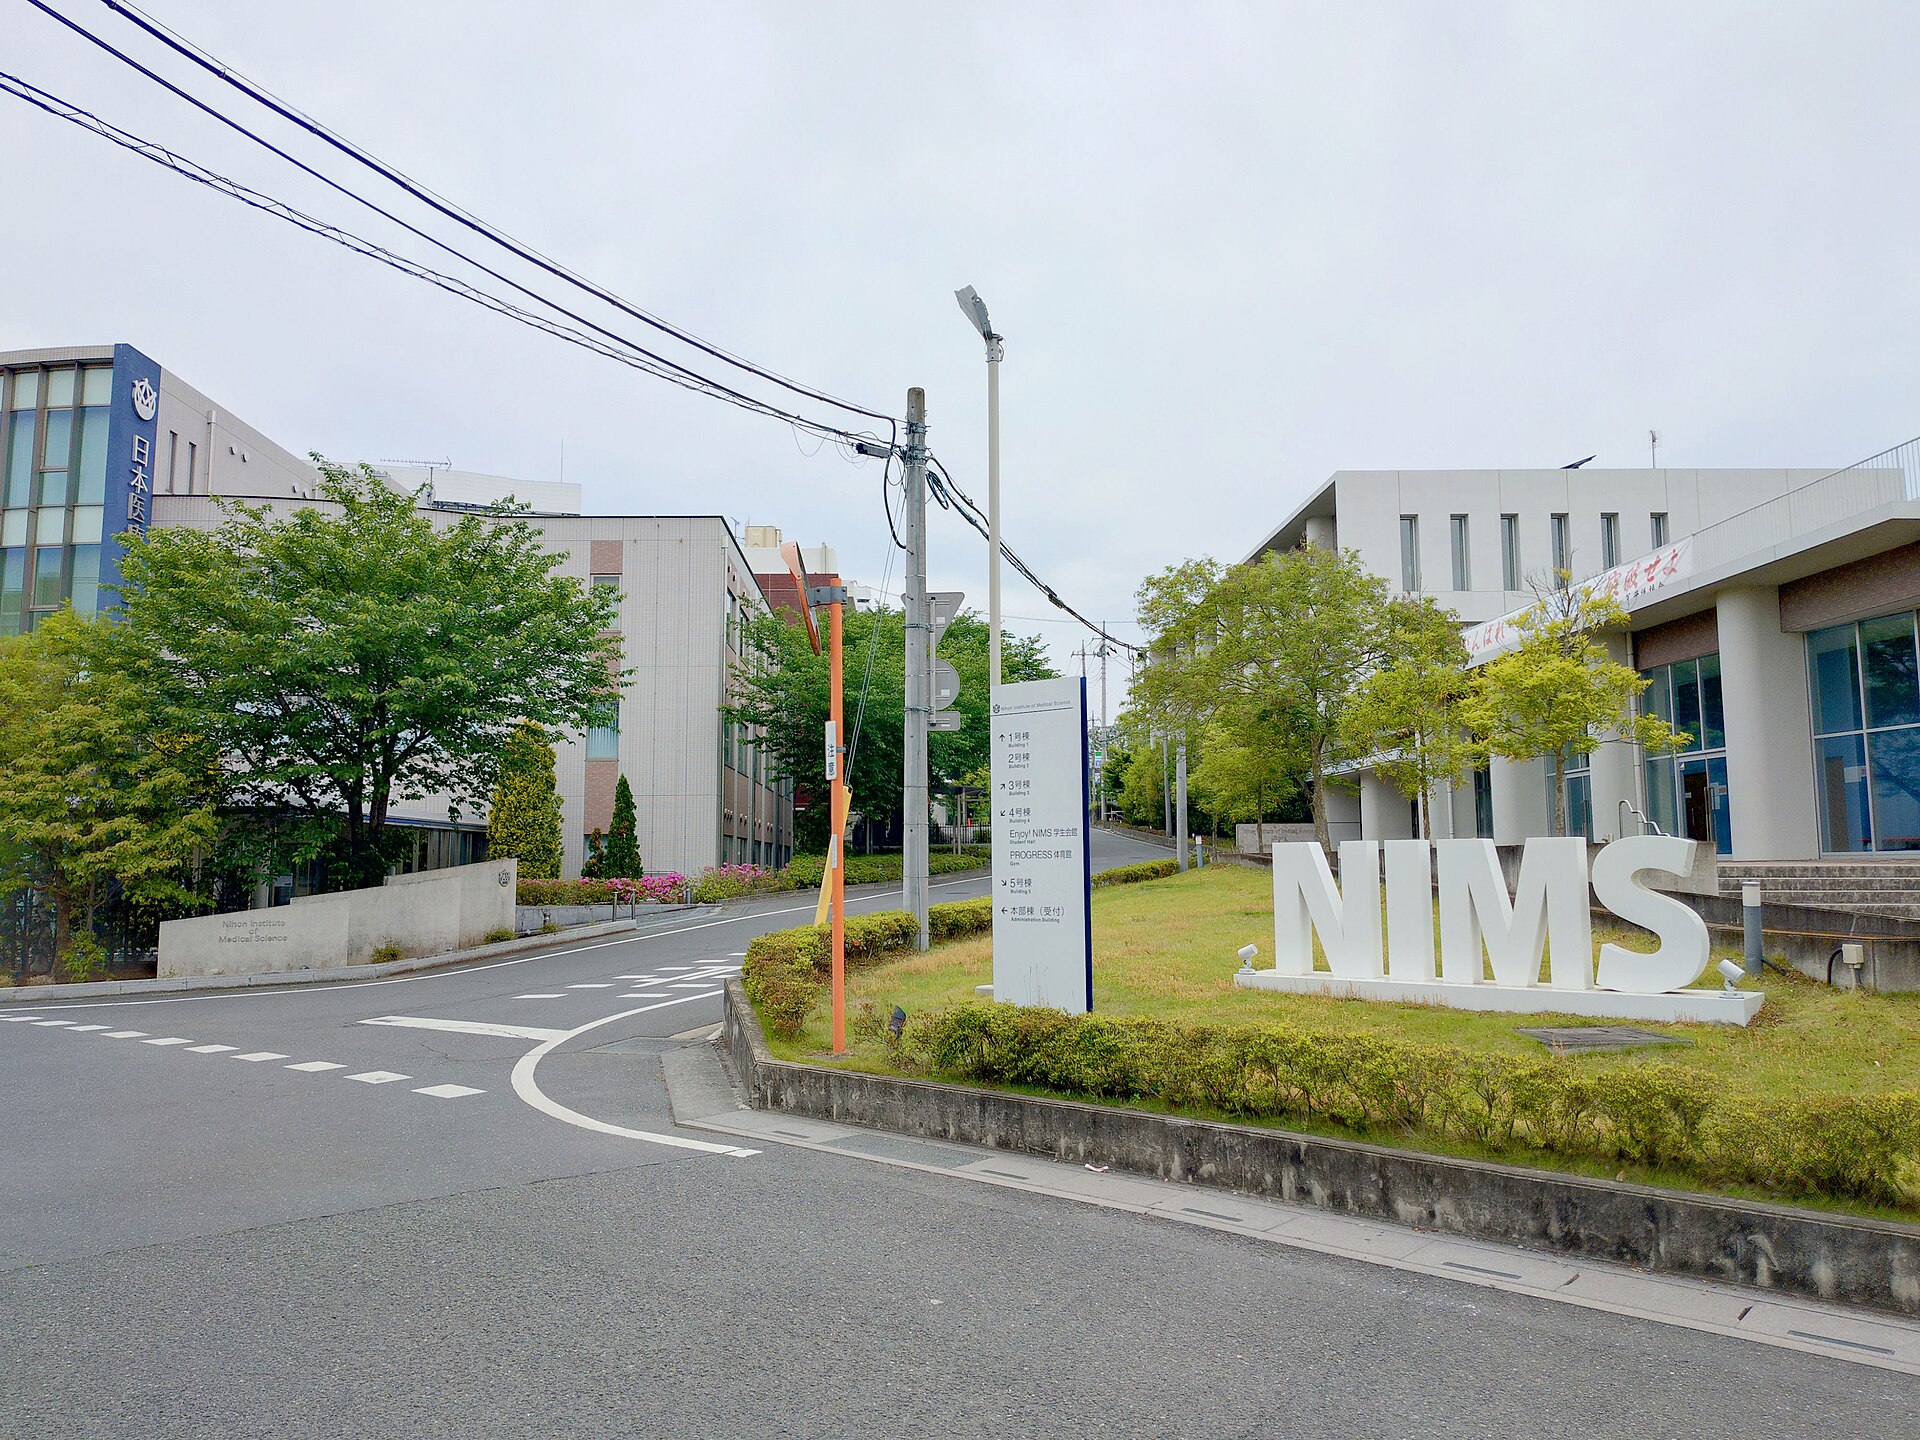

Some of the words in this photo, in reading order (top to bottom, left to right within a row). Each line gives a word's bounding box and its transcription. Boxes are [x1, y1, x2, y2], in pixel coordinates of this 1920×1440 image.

[1008, 732, 1030, 742] 1号棟
[1008, 753, 1030, 763] 2号棟
[1008, 780, 1031, 790] 3号棟
[1008, 807, 1031, 817] 4号棟
[1009, 829, 1031, 839] Enjoy!
[1032, 828, 1052, 837] NIMS
[1053, 827, 1078, 837] 学生会館
[1010, 850, 1052, 859] PROGRESS
[1053, 850, 1072, 859] 体育館
[1009, 878, 1032, 888] 5号棟
[1271, 834, 1710, 994] NIMS
[218, 935, 253, 943] Medical
[254, 934, 288, 942] Science
